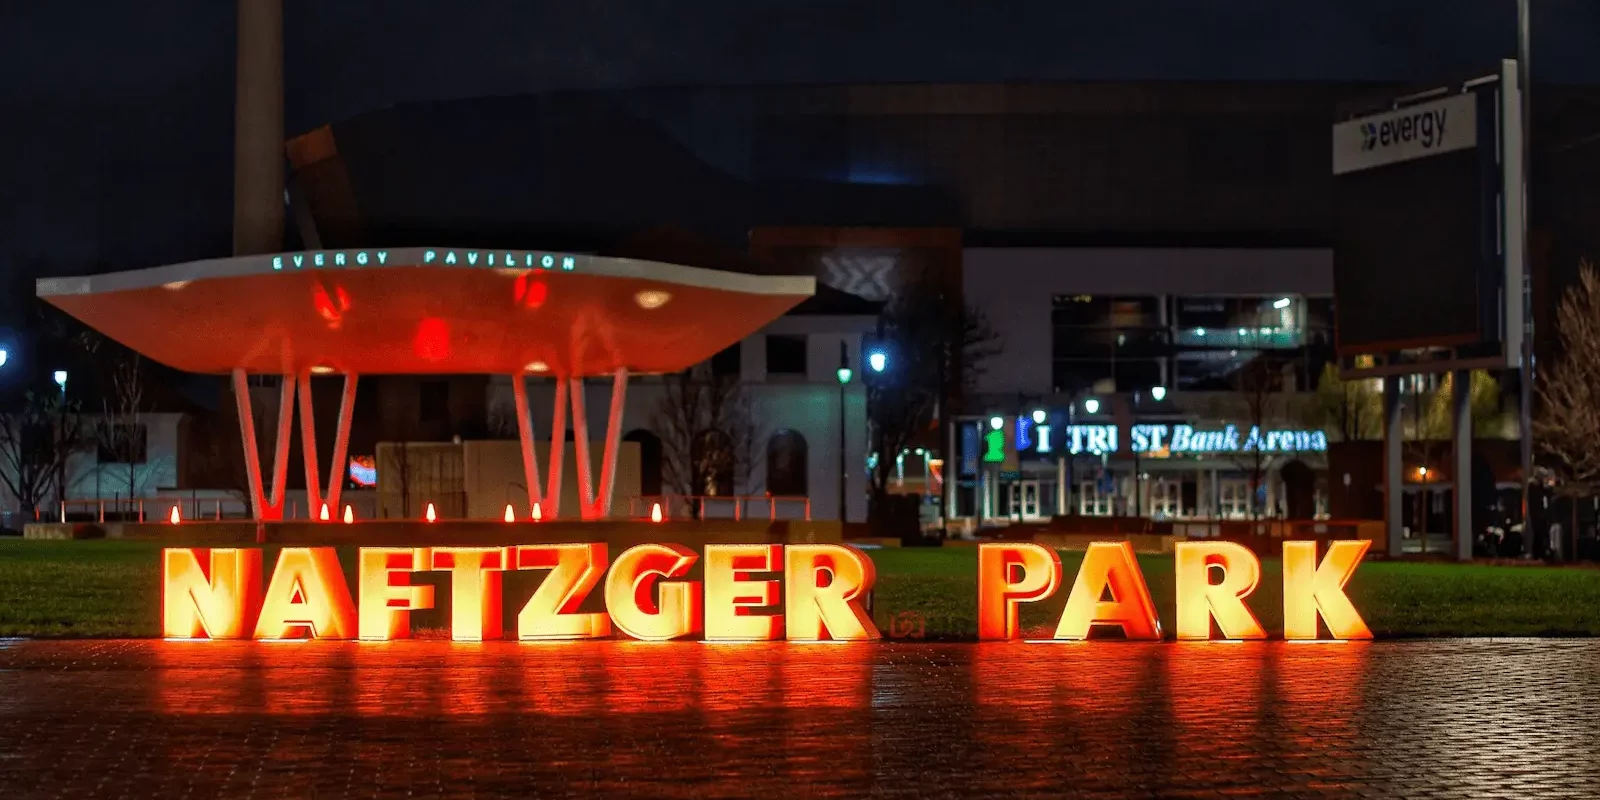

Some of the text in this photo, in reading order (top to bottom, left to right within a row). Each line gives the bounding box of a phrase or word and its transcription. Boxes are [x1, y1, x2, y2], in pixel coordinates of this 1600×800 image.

[1380, 109, 1447, 148] evergy
[272, 251, 575, 270] EVERGY PAVILION
[1036, 424, 1328, 453] ITRST Bank Arena
[162, 539, 1373, 641] NAFTZGER PARK
